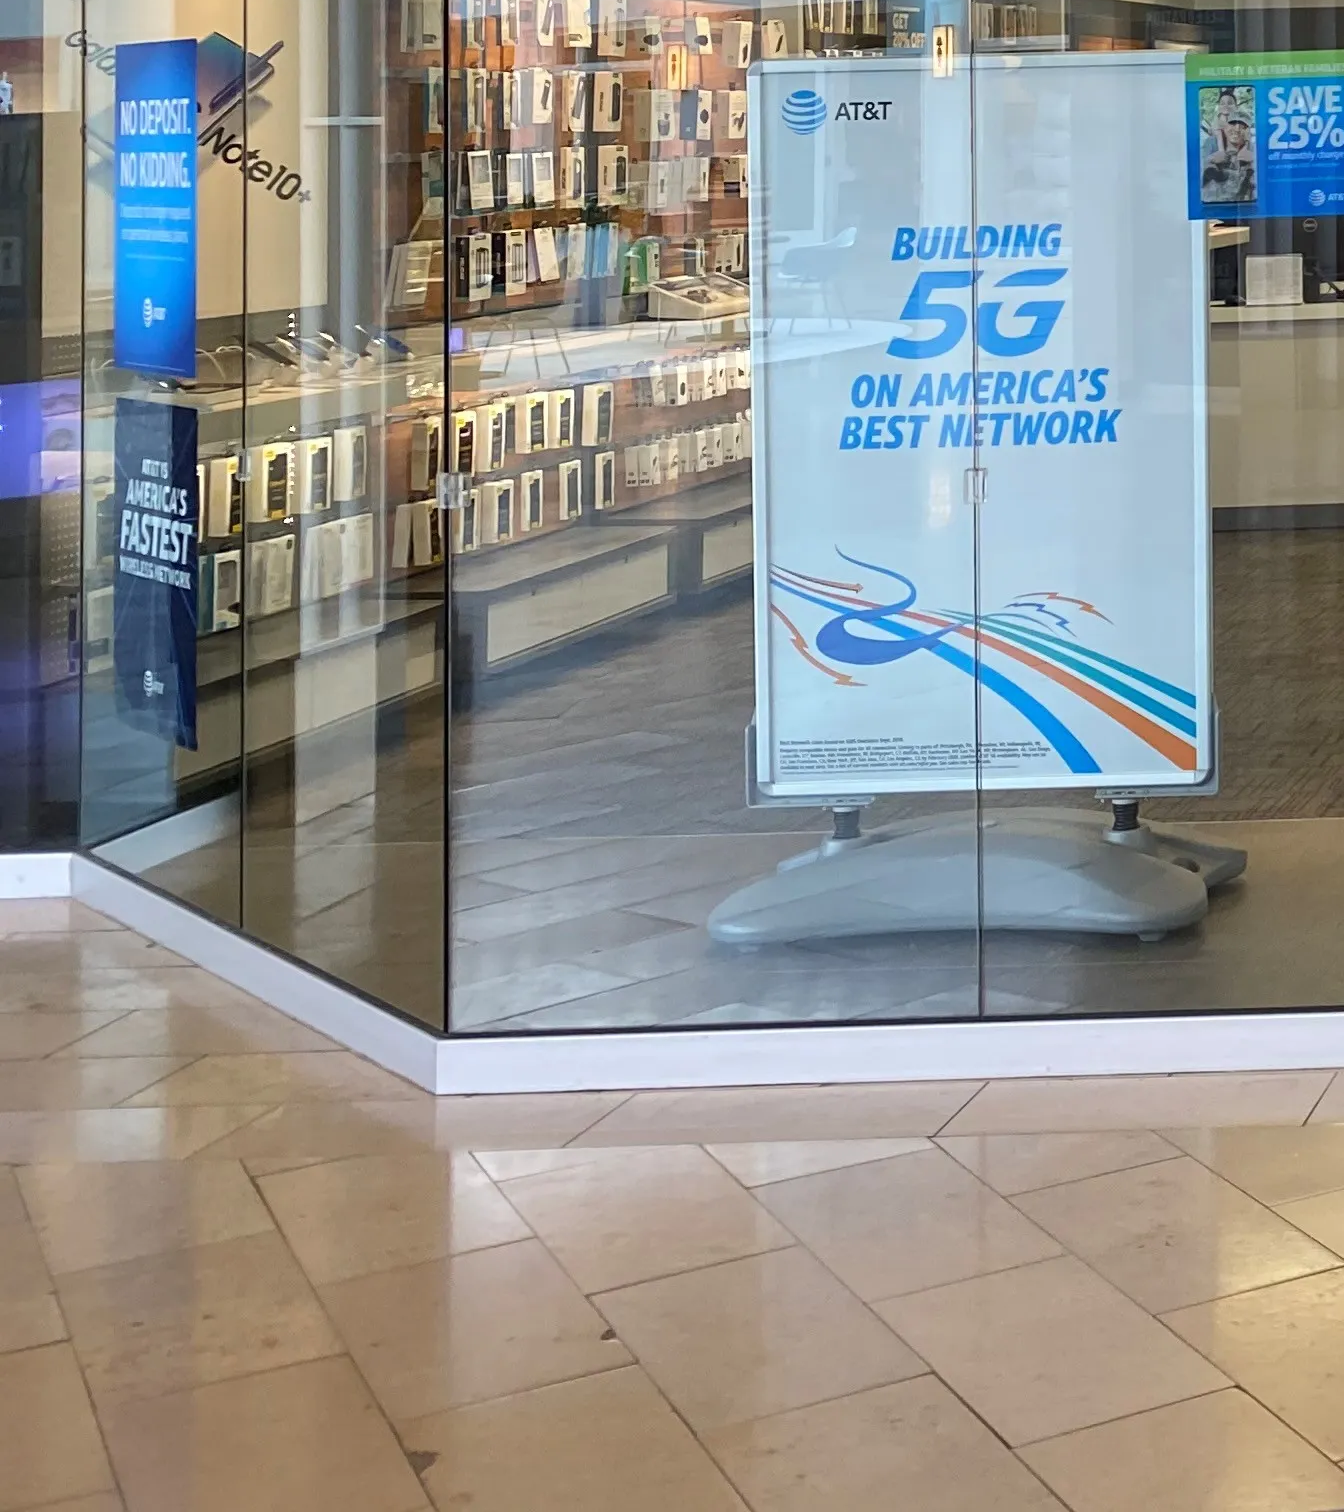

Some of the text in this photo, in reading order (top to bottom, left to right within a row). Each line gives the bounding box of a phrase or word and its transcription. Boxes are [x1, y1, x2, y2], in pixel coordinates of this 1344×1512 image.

[120, 98, 192, 136] NO DEPOSIT.
[834, 101, 892, 121] AT&T
[1268, 85, 1343, 115] SAVE
[120, 152, 192, 188] NO KIDDING.
[200, 127, 311, 203] Note10+
[891, 223, 1063, 261] BUILDING
[885, 267, 1069, 360] 5G
[851, 368, 1110, 408] ON AMERICA'S
[839, 408, 1123, 450] BEST NETWORK
[125, 478, 188, 517] AMERICA'S
[120, 509, 193, 565] FASTEST
